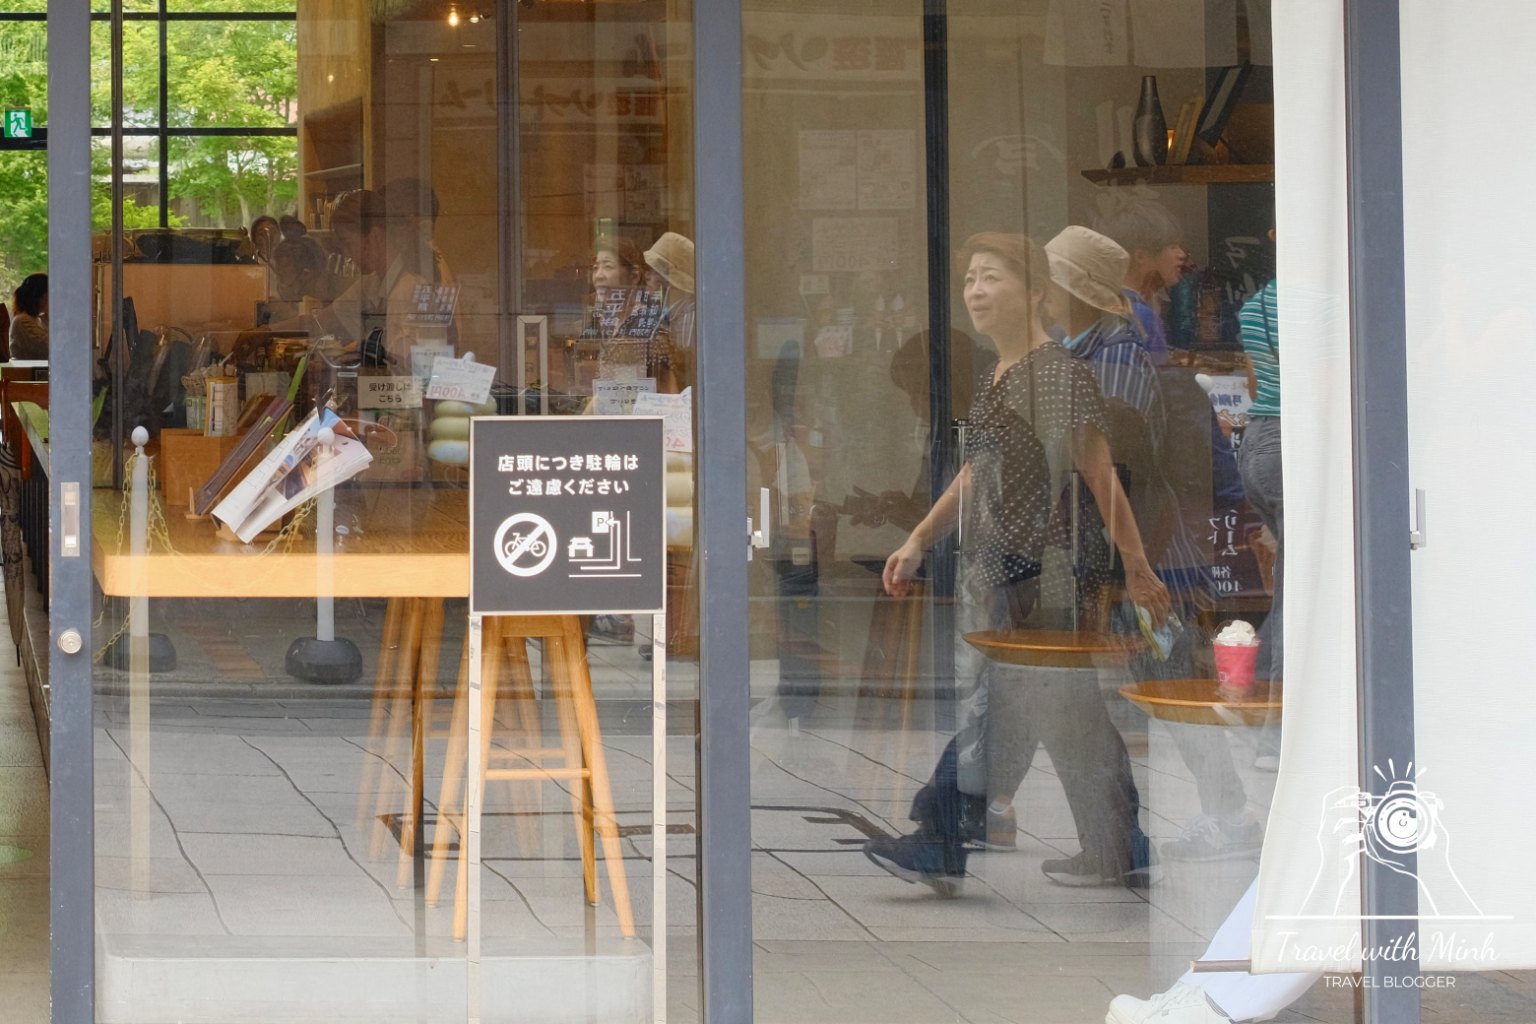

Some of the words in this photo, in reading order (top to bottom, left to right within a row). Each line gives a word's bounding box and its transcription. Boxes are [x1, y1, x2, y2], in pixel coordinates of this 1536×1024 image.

[379, 394, 402, 403] こちら
[498, 455, 639, 472] 店頭につき駐輪は
[508, 479, 629, 496] ご遠慮ください
